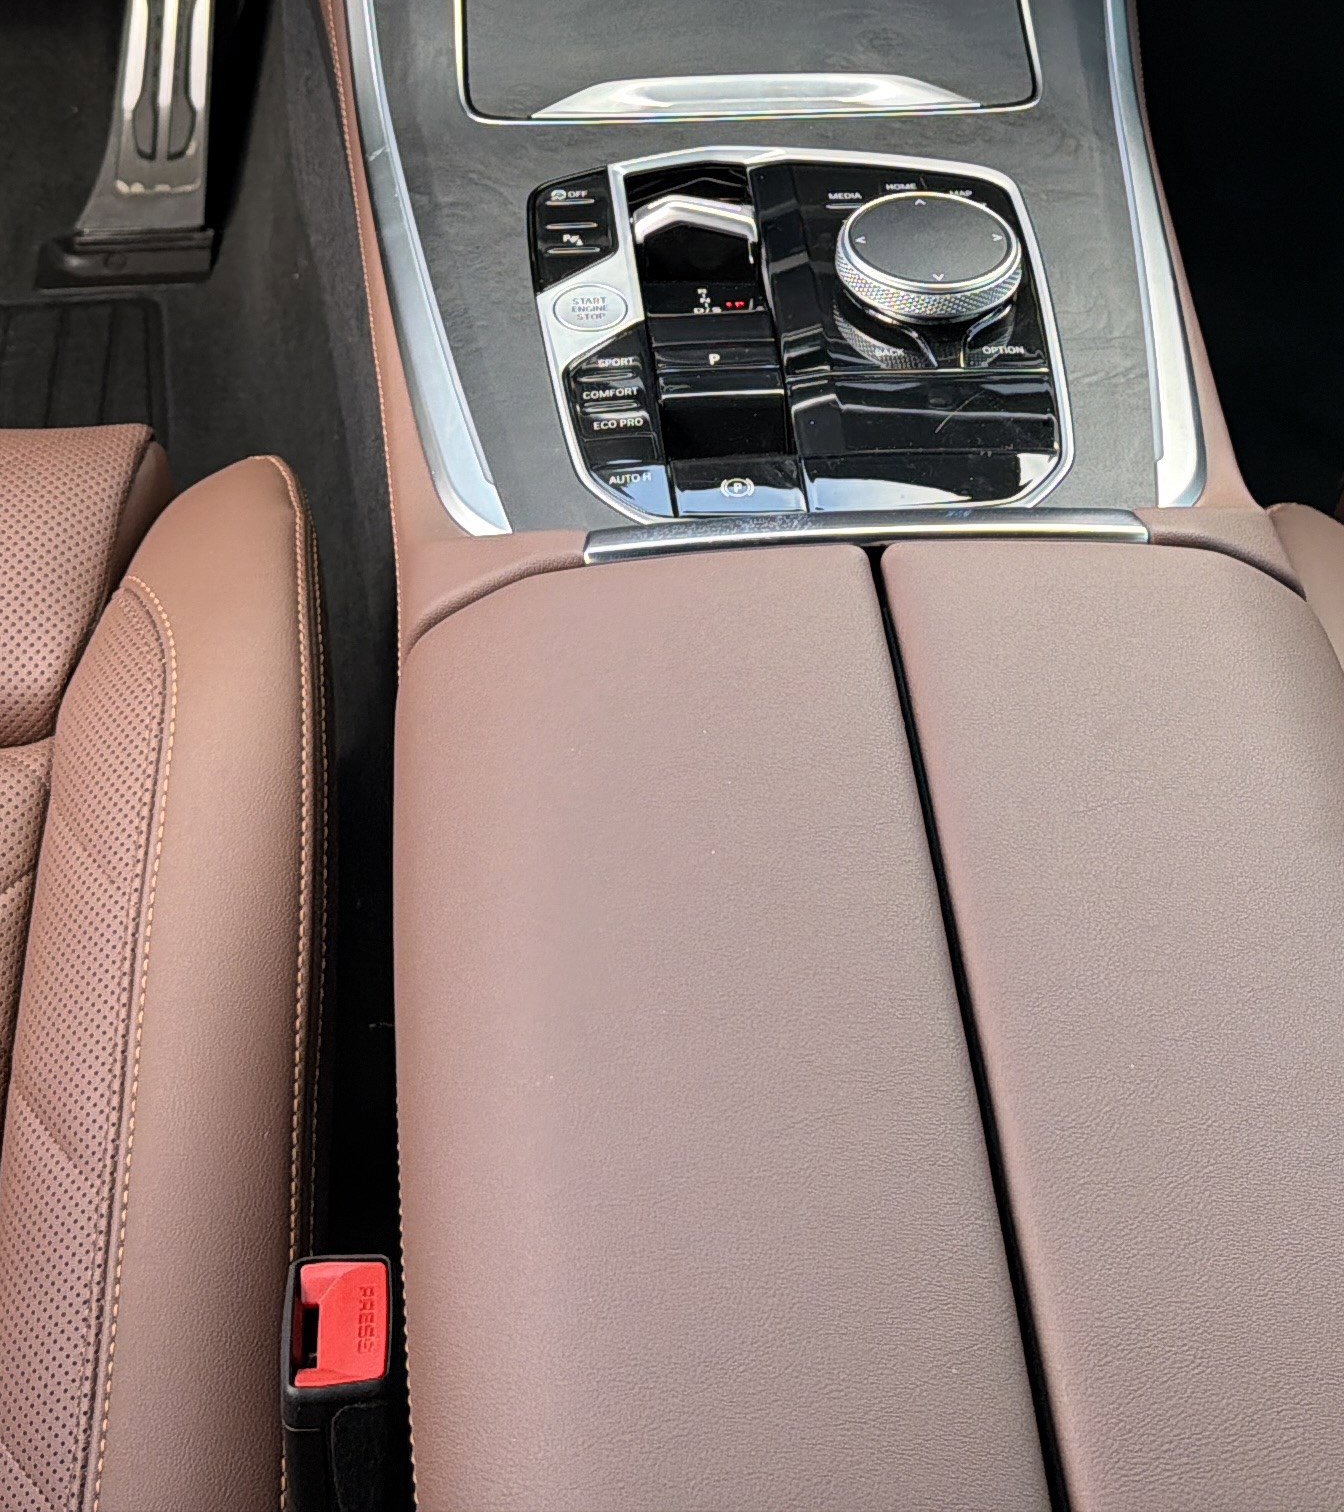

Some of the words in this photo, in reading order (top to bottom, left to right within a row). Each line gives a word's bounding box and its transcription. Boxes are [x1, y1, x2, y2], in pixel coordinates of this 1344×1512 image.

[885, 182, 917, 190] HOME
[567, 190, 588, 198] OFF
[828, 191, 862, 200] MEDIA
[572, 296, 607, 305] START
[571, 305, 608, 313] ENGINE
[576, 313, 606, 321] STOP
[981, 345, 1025, 355] OPTION
[597, 356, 635, 368] SPORT
[709, 353, 720, 365] P
[582, 387, 638, 400] COMFORT
[593, 419, 617, 431] ECO
[619, 418, 643, 428] PRO
[608, 474, 642, 485] AUTO
[643, 472, 652, 482] H
[357, 1287, 375, 1354] PRESS
